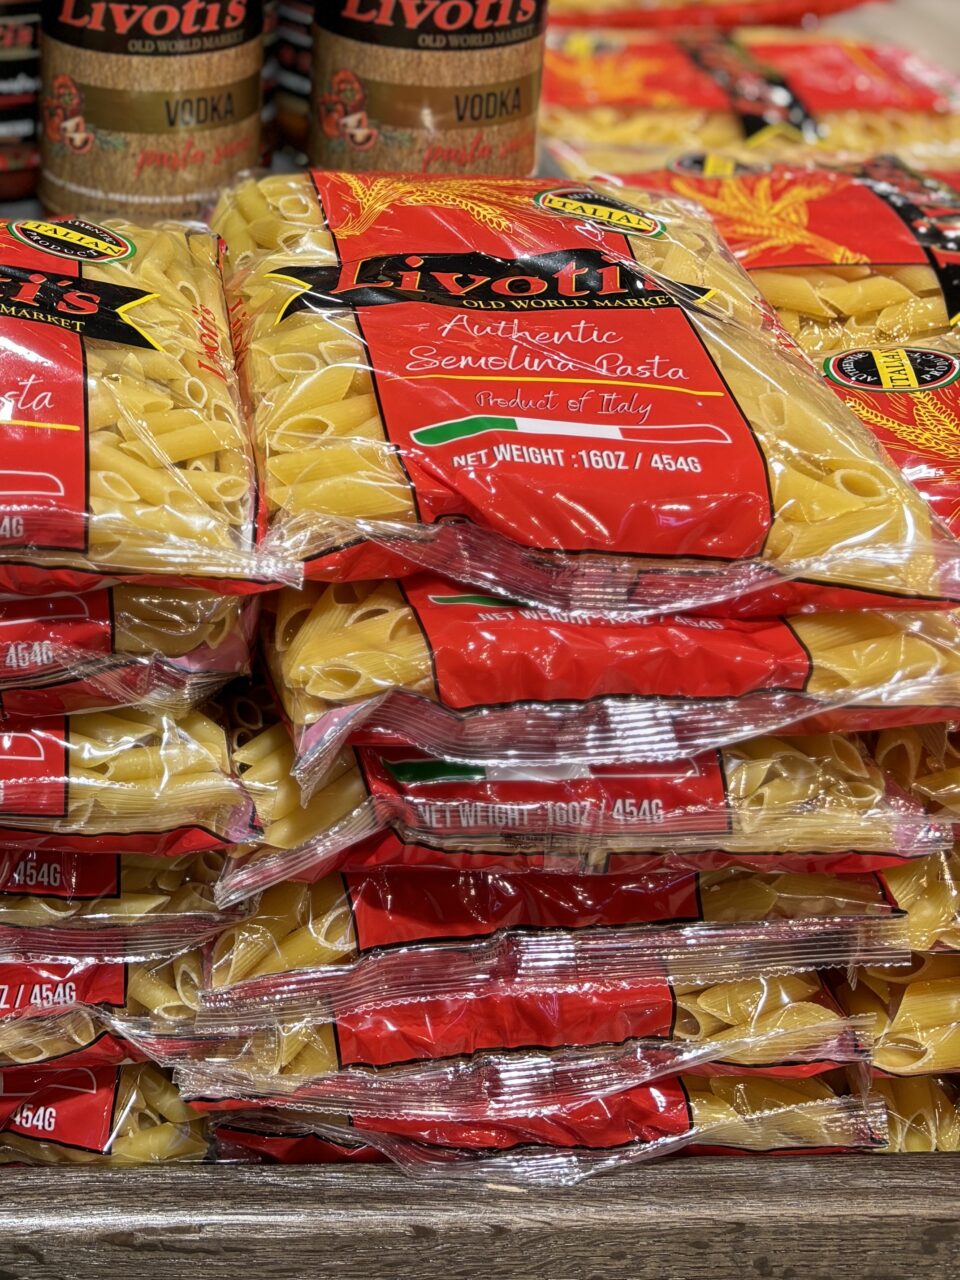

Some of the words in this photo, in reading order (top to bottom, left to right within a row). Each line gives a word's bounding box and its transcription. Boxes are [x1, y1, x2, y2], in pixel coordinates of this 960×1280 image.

[128, 38, 156, 52] OLD
[157, 37, 202, 52] WORLD
[418, 33, 447, 47] OLD
[448, 32, 493, 47] WORLD
[165, 91, 235, 128] VODKA
[454, 87, 522, 123] VODKA
[546, 197, 655, 228] ITALIAN
[21, 220, 122, 256] ITALIAN
[25, 230, 100, 257] PRODUCT
[462, 298, 505, 310] OLD
[510, 298, 588, 309] WORLD
[440, 313, 624, 345] Authentic
[405, 345, 581, 372] Semolina
[595, 352, 690, 381] Pasta
[841, 351, 879, 383] AUTHENTIC
[880, 348, 912, 388] ITALIAN
[474, 388, 560, 412] Product
[566, 389, 595, 413] of
[597, 391, 653, 425] Italy
[452, 449, 489, 468] NET
[493, 443, 566, 468] WEIGHT
[633, 452, 643, 470] /
[650, 452, 702, 473] 454G
[477, 611, 516, 622] NET
[417, 803, 453, 828] NET
[458, 803, 529, 828] WEIGHT
[611, 799, 665, 825] 454G
[16, 861, 62, 886] 454G
[14, 984, 25, 1009] /
[30, 981, 77, 1008] 454G
